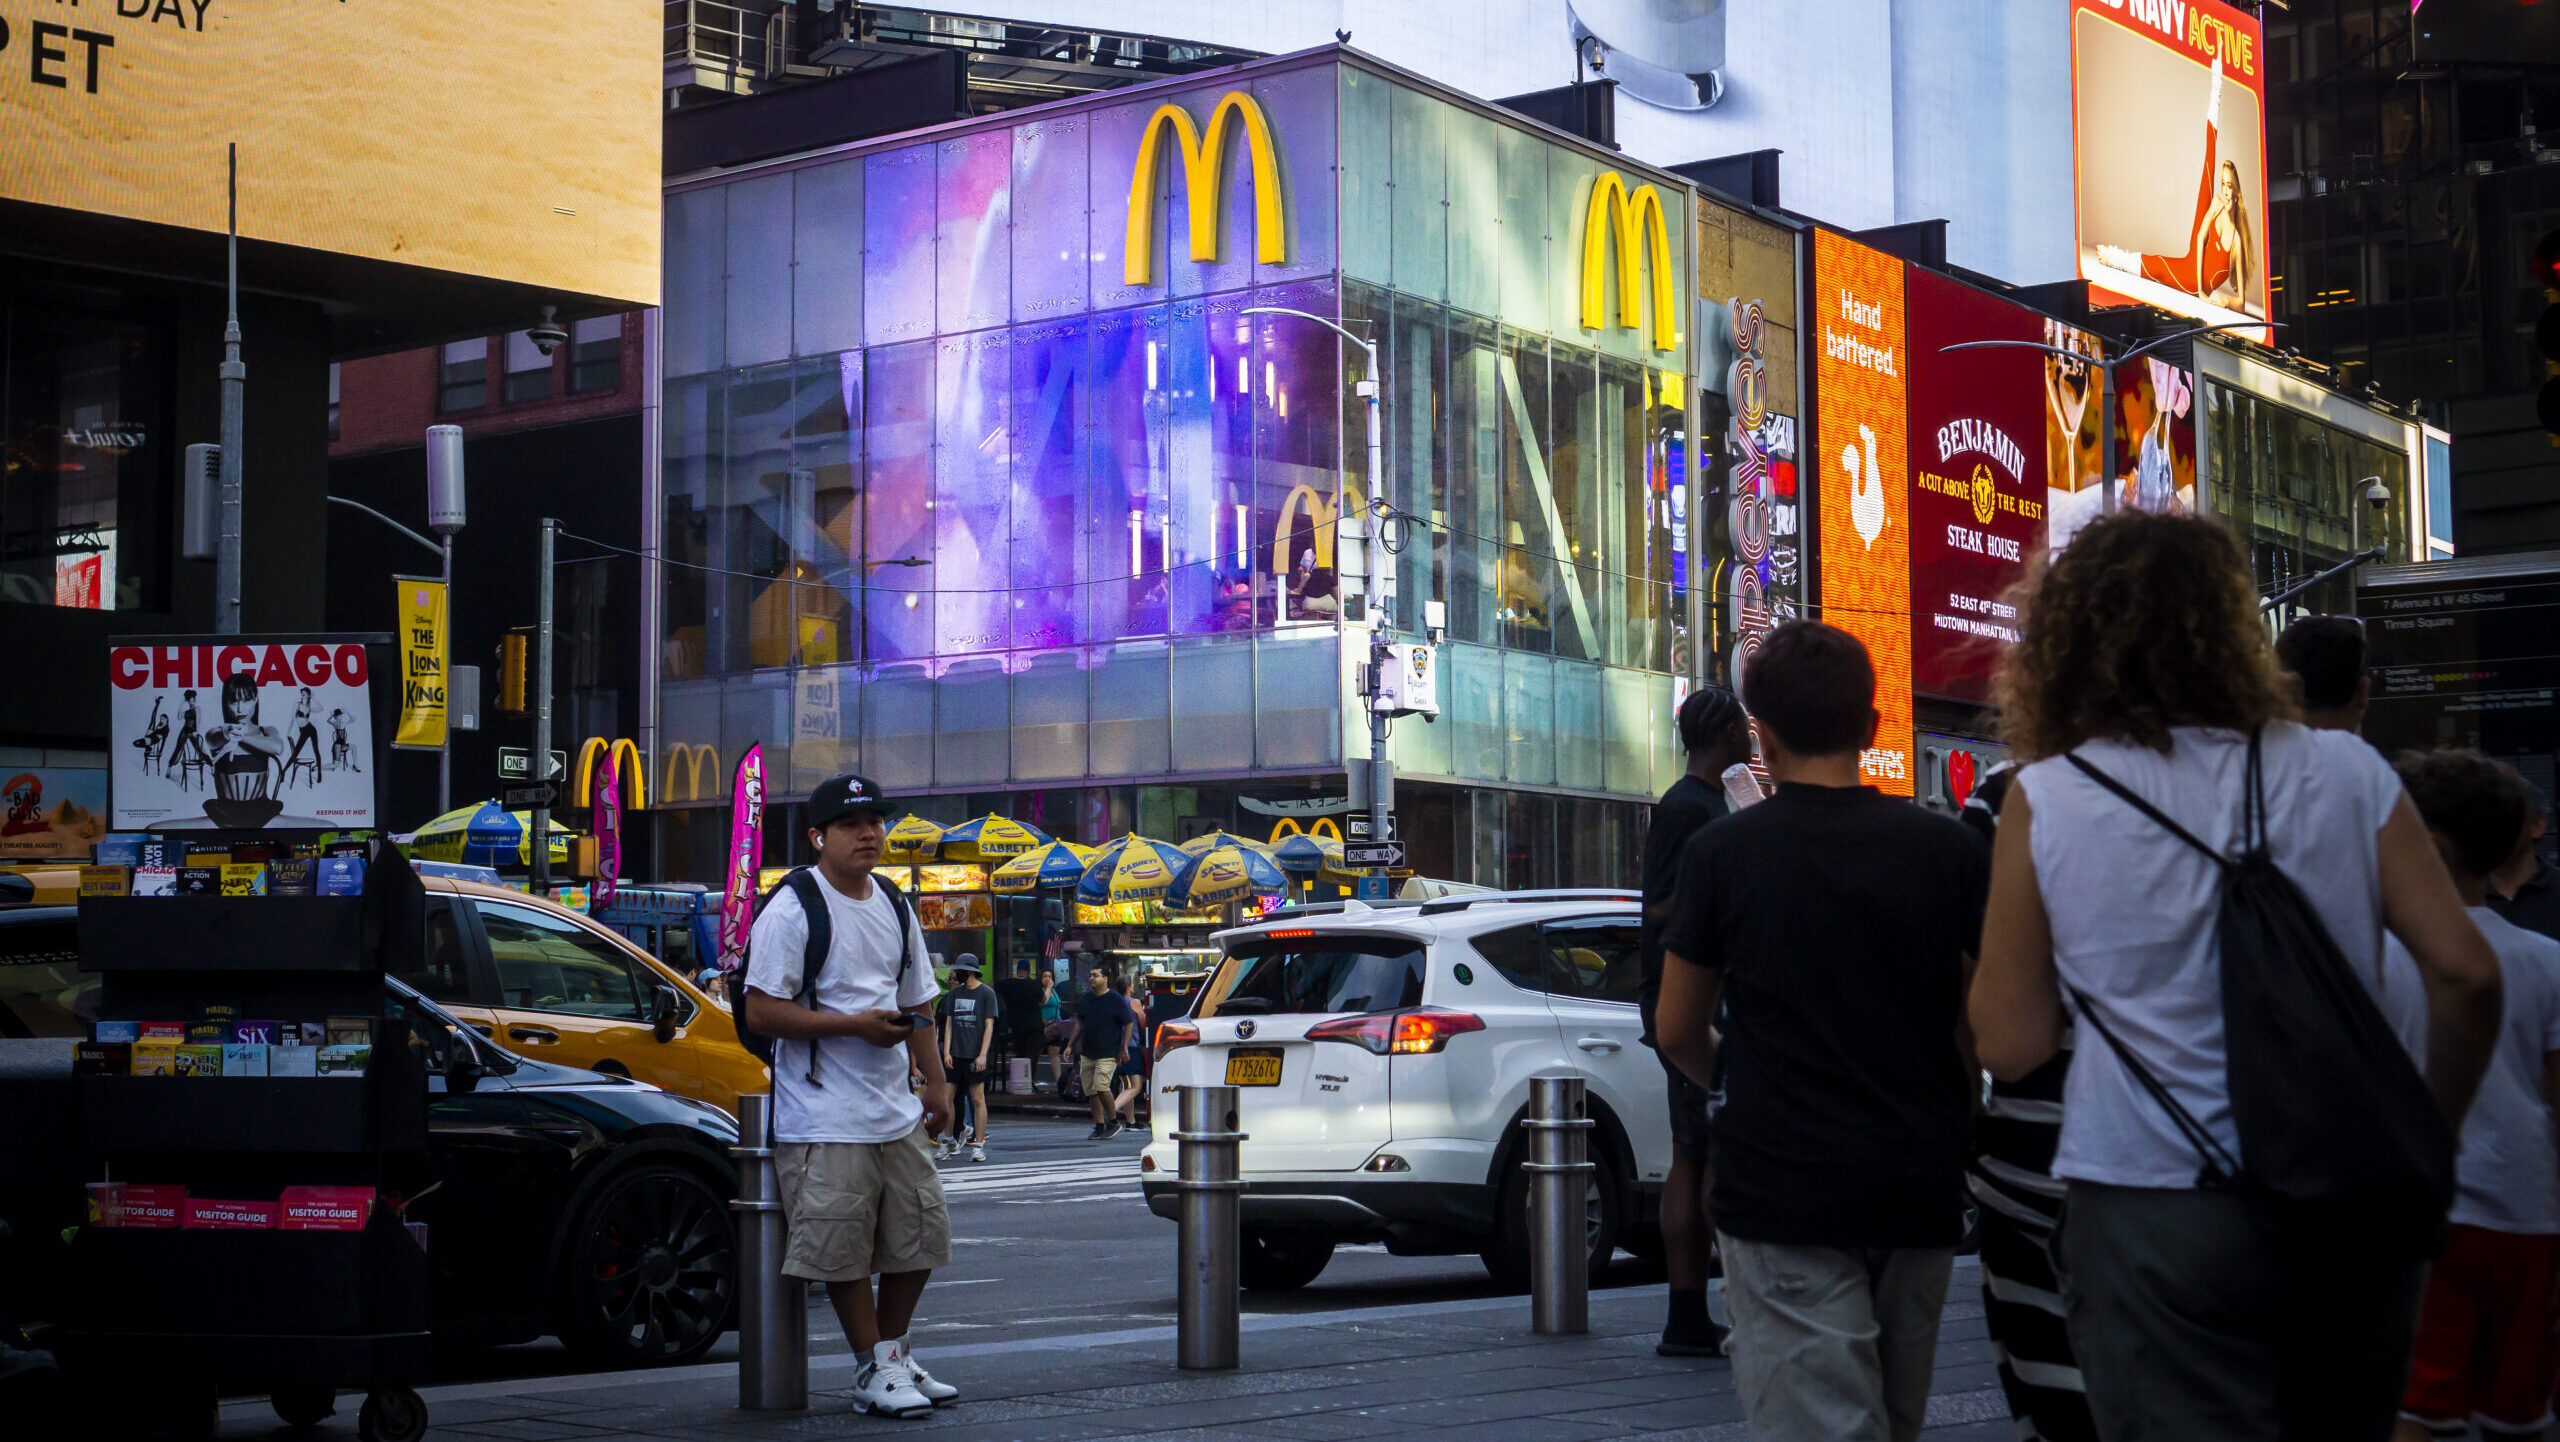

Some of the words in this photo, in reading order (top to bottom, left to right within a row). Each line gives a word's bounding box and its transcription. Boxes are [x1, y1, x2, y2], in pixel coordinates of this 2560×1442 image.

[2189, 6, 2254, 76] ACTIVE
[1841, 288, 1881, 331] Hand
[1826, 325, 1897, 378] battered.
[1937, 418, 2026, 484] BENJAMIN
[1918, 471, 1926, 488] A
[1926, 472, 1942, 493] CUT
[1942, 478, 1970, 500] ABOVE
[1997, 492, 2016, 513] THE
[2018, 499, 2042, 520] REST
[1947, 524, 1984, 554] STEAK
[1988, 534, 2021, 562] HOUSE
[1950, 593, 1959, 607] 52
[1960, 595, 1979, 612] EAST
[1992, 602, 2017, 619] STREET
[2383, 600, 2389, 611] 7
[2391, 597, 2431, 610] Avenue
[2432, 596, 2441, 607] &
[2442, 595, 2455, 606] W
[2456, 593, 2470, 604] 45
[2472, 591, 2505, 603] Street
[1934, 612, 1969, 634] MIDTOWN
[2384, 619, 2415, 631] Times
[2416, 617, 2455, 630] Square
[412, 629, 434, 645] THE
[110, 644, 367, 690] CHICAGO
[409, 650, 440, 677] LION
[406, 679, 444, 709] KING
[506, 757, 524, 769] ONE
[14, 791, 41, 807] BAD
[510, 790, 527, 802] ONE
[535, 789, 552, 800] WAY
[8, 806, 41, 822] GUYS
[1354, 823, 1368, 832] ONE
[981, 843, 1036, 854] SABRETT
[1350, 851, 1367, 860] ONE
[1376, 850, 1396, 860] WAY
[134, 865, 177, 875] CHICAG
[1119, 858, 1157, 875] SABRETT
[992, 876, 1036, 888] SABRETT
[1114, 886, 1165, 901] SABRET
[1231, 1059, 1276, 1078] T735267C
[146, 1207, 175, 1216] GUIDE
[195, 1210, 234, 1220] VISITOR
[236, 1213, 267, 1222] GUIDE
[289, 1208, 326, 1217] VISITOR
[328, 1209, 357, 1218] GUIDE
